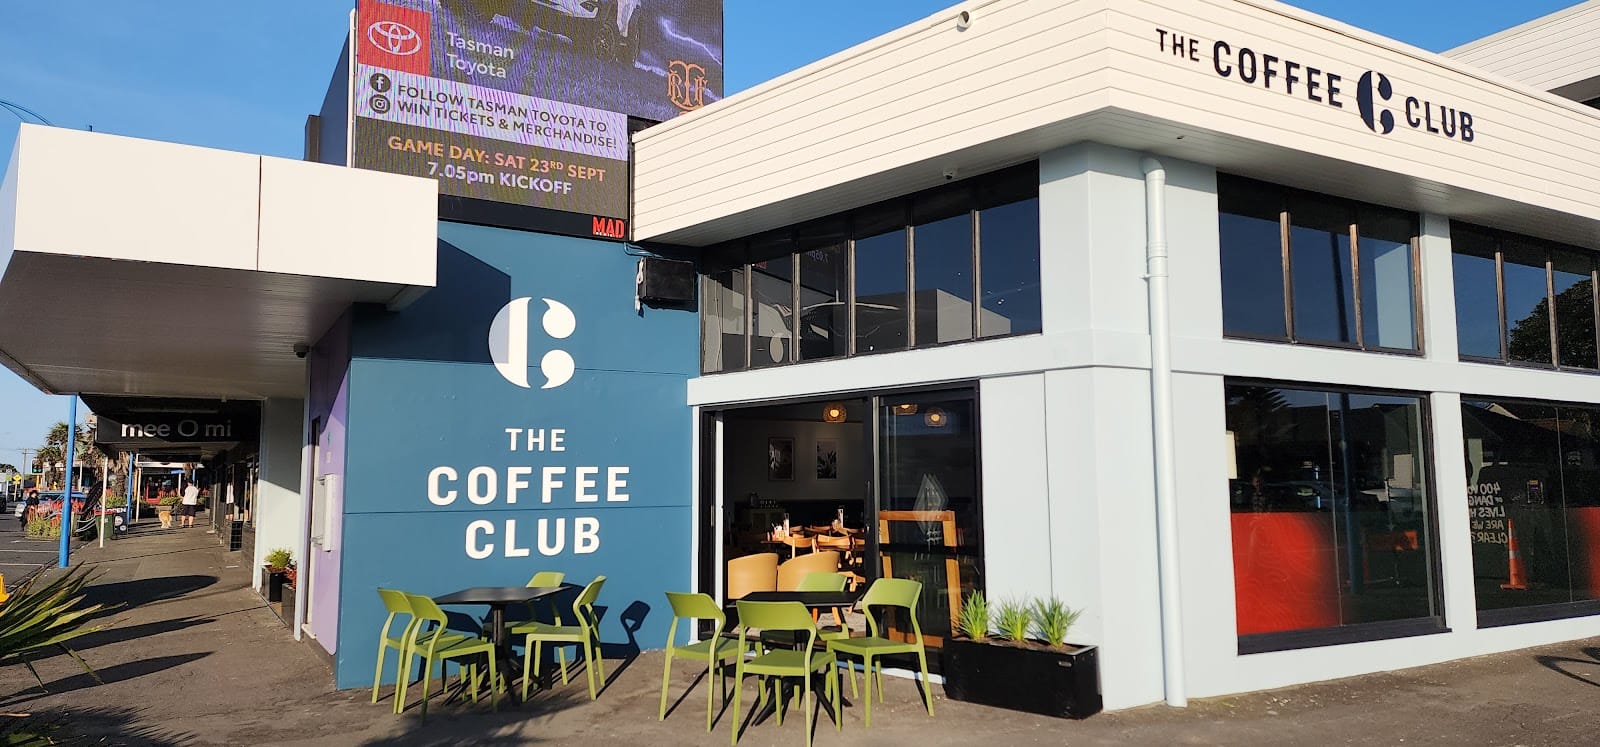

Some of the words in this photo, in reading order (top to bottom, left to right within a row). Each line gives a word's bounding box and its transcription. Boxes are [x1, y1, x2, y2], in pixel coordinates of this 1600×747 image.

[446, 31, 515, 60] Tasman
[446, 52, 507, 79] Toyota
[1156, 28, 1200, 62] THE
[1213, 40, 1343, 108] COFFEE
[1405, 96, 1474, 142] CLUB
[398, 85, 464, 106] FOLLOW
[467, 97, 528, 118] TASMAN
[532, 110, 585, 129] TOYOTA
[589, 120, 607, 132] TO
[398, 101, 430, 116] WIN
[435, 107, 495, 127] TICKETS
[499, 119, 509, 130] &
[513, 121, 617, 149] MERCHANDISE!
[388, 136, 444, 157] GAME
[450, 145, 490, 165] DAY:
[494, 152, 526, 169] SAT
[568, 164, 606, 182] SEPT
[427, 161, 495, 185] 7.05pm
[499, 172, 572, 195] KICKOFF
[592, 216, 625, 238] MAD
[121, 423, 170, 438] mee
[178, 419, 199, 437] O
[205, 419, 232, 437] mi
[505, 428, 566, 452] THE
[427, 466, 630, 506] COFFEE
[465, 517, 600, 560] CLUB
